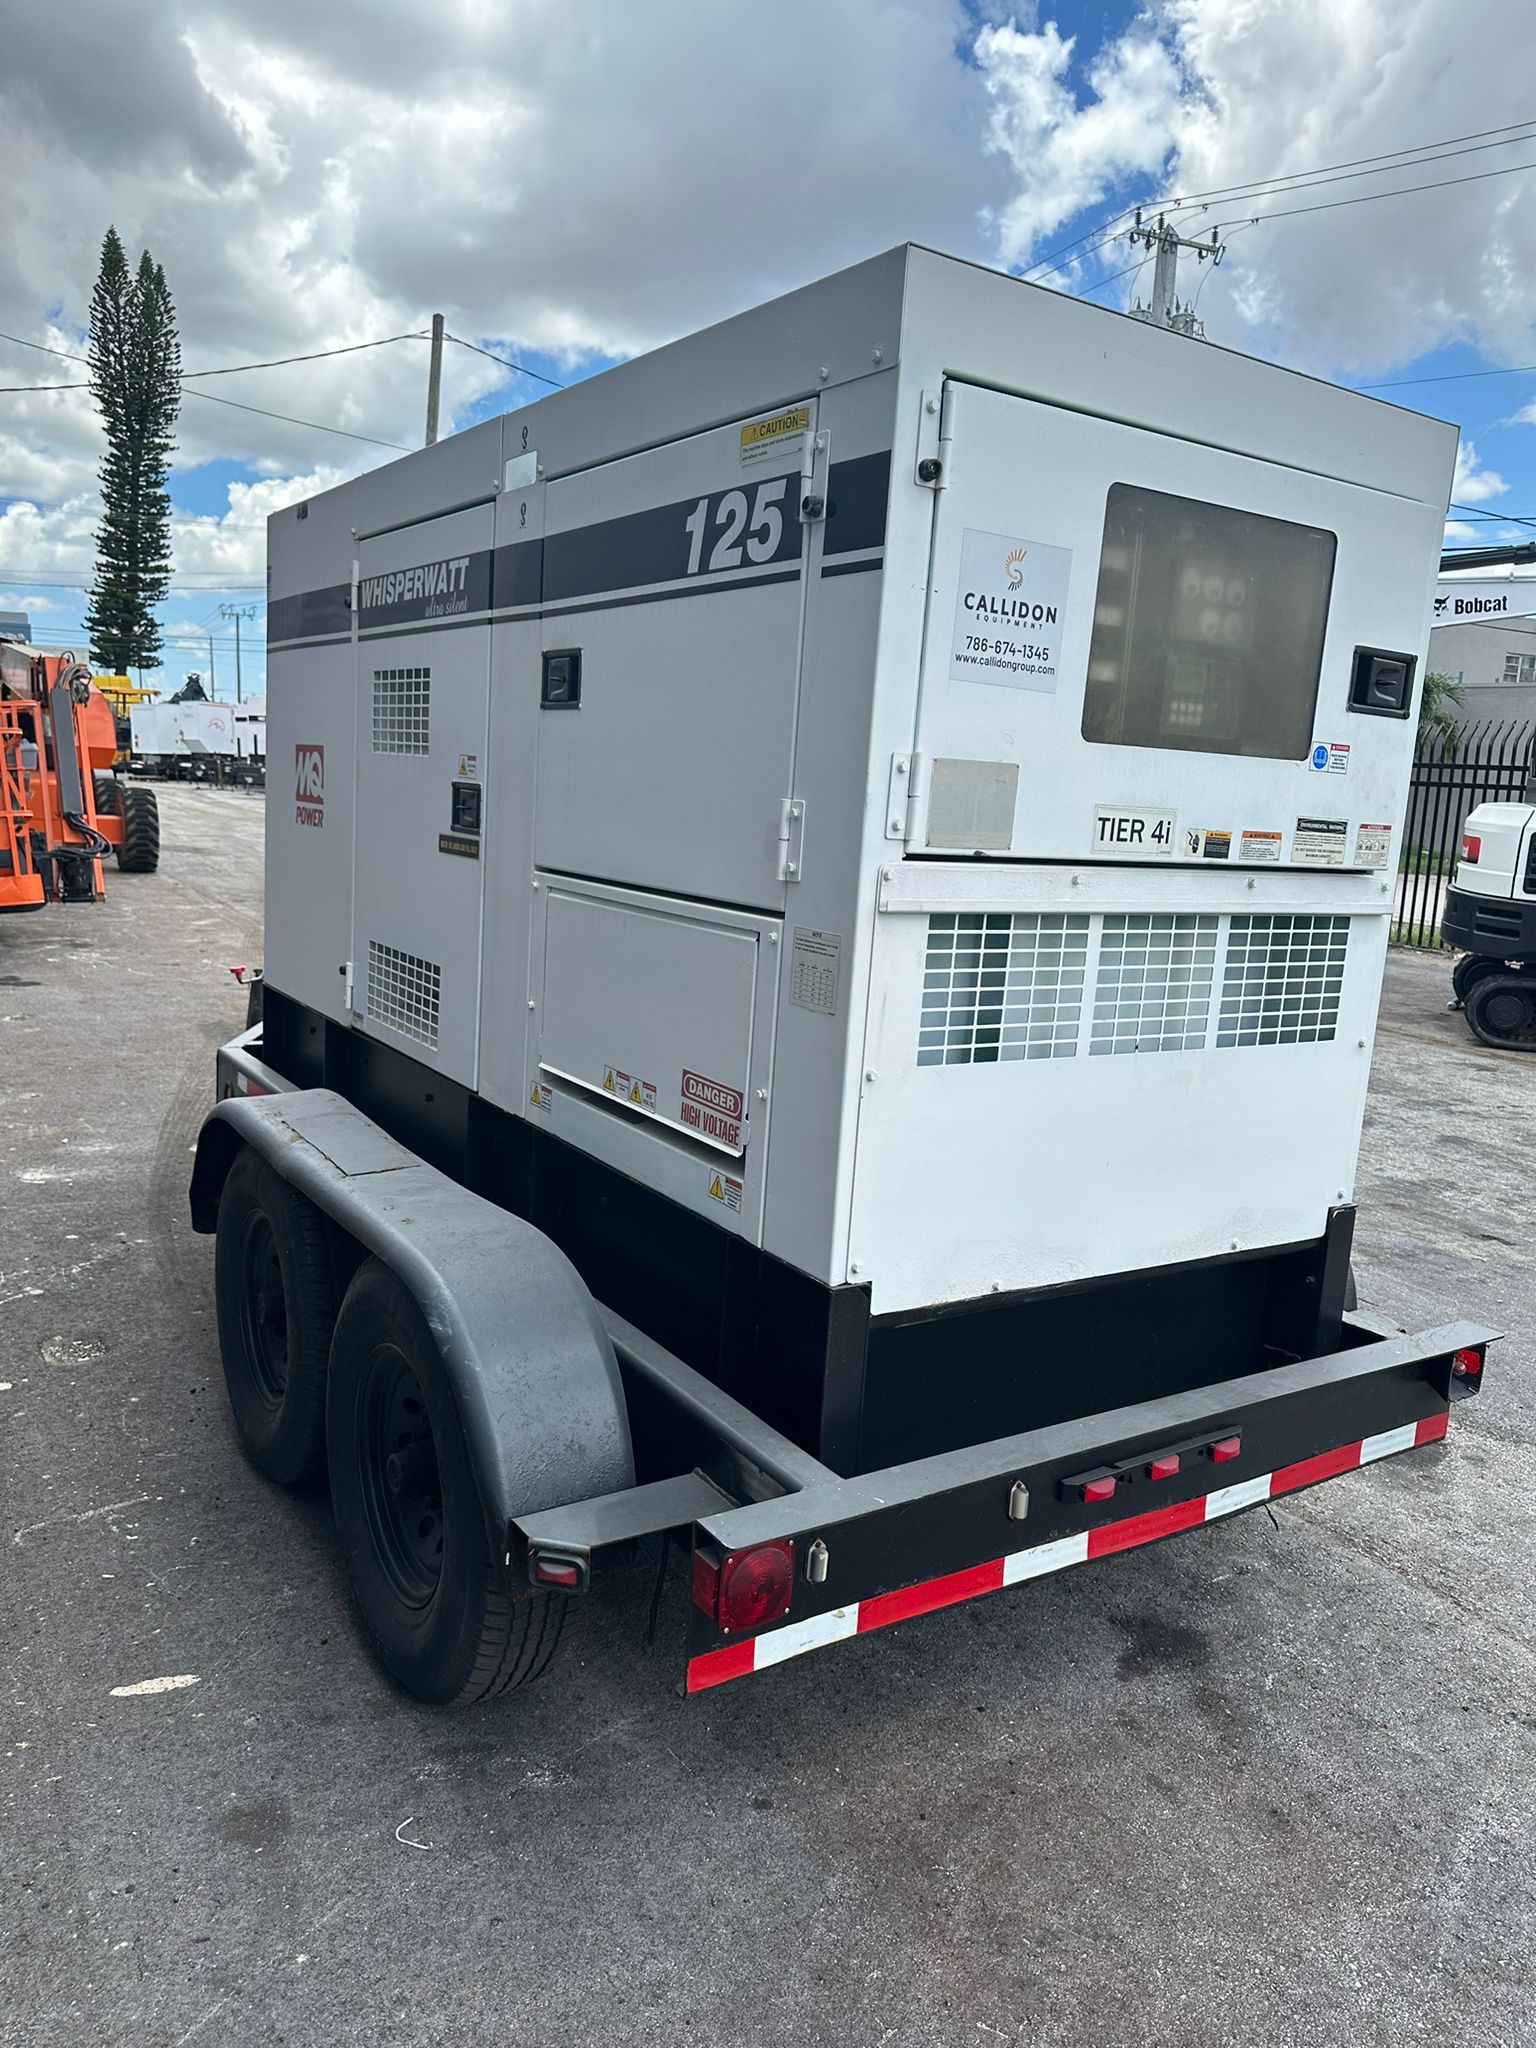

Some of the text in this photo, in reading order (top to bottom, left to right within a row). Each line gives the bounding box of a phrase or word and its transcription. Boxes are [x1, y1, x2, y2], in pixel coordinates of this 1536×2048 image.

[759, 414, 799, 437] CAUTION
[685, 478, 787, 574] 125
[361, 557, 470, 609] WHISPERWATT
[425, 592, 468, 617] ultra silent
[964, 592, 1058, 624] CALLIDON
[1454, 596, 1508, 614] Bobcat
[976, 614, 1042, 630] EQUIPMENT
[966, 636, 1050, 662] 786-674-1345
[955, 654, 1055, 676] www.callidongroup.com
[296, 751, 324, 798] MQ
[296, 806, 324, 828] POWER
[1098, 817, 1171, 844] TIER 4i
[688, 1079, 735, 1111] DANGER
[680, 1101, 740, 1146] HIGH VOLTAGE
